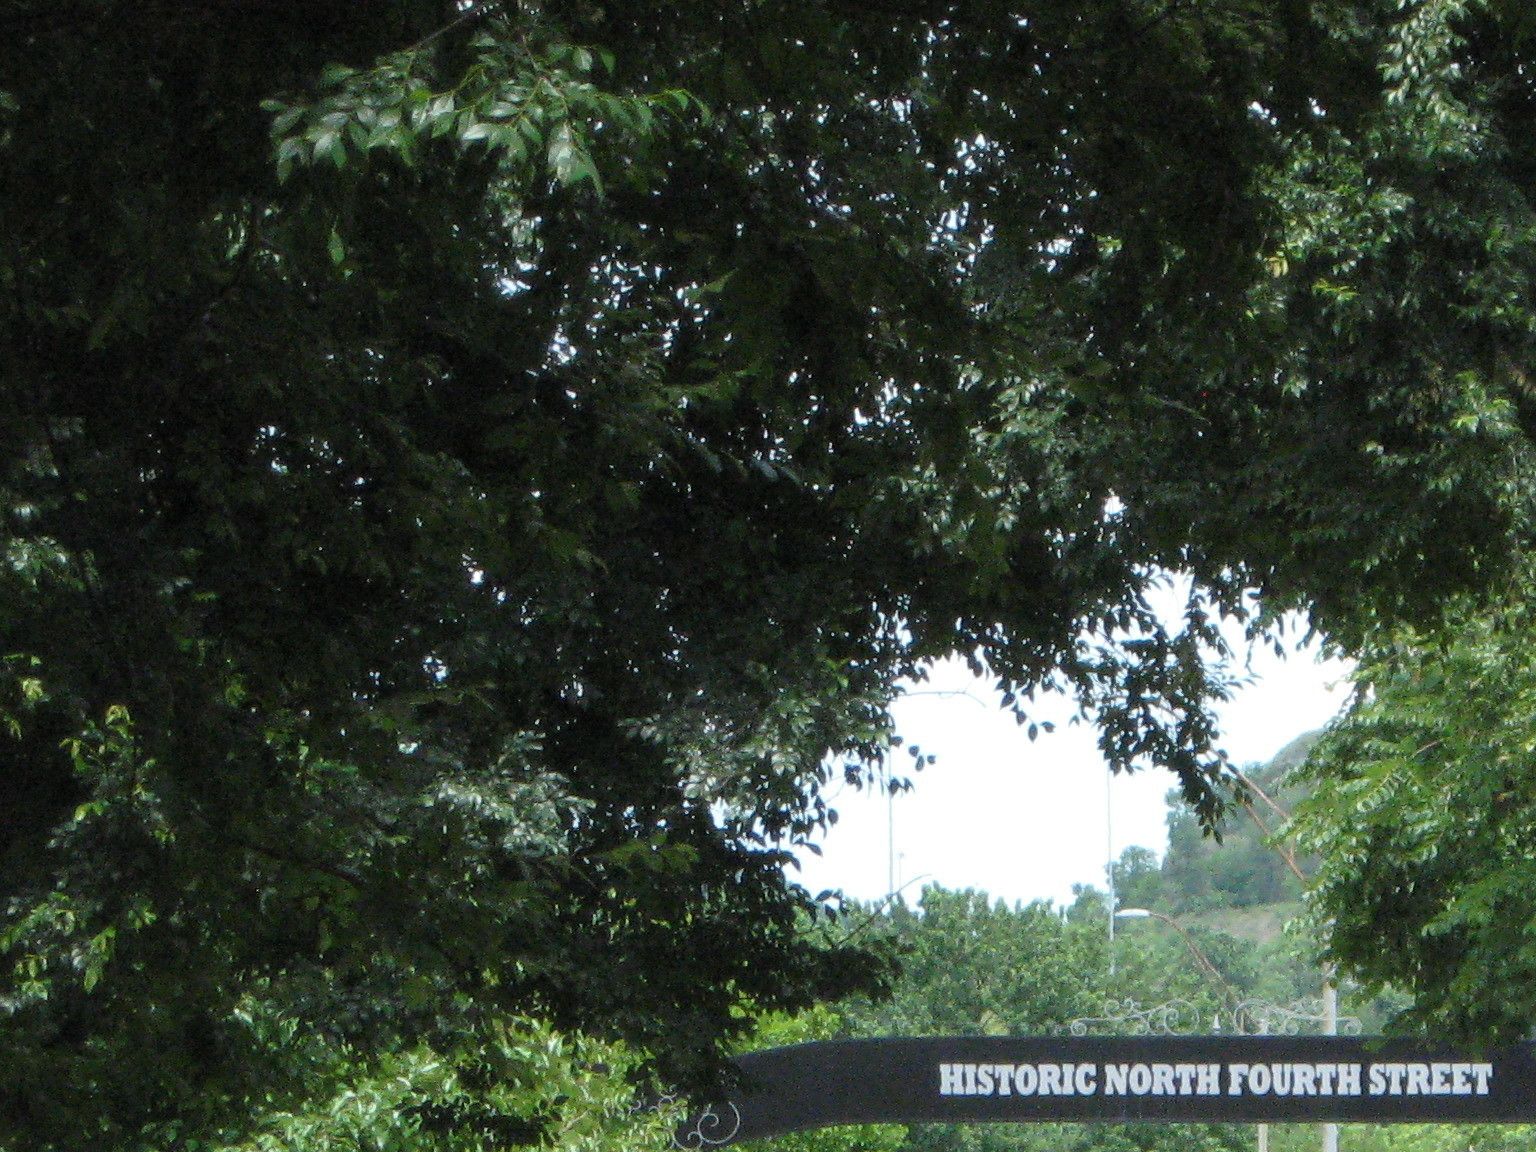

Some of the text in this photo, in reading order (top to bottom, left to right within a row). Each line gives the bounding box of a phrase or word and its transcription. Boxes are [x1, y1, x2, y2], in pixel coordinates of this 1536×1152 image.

[939, 1063, 1493, 1096] HISTORIC NORTH FOURTH STREET
